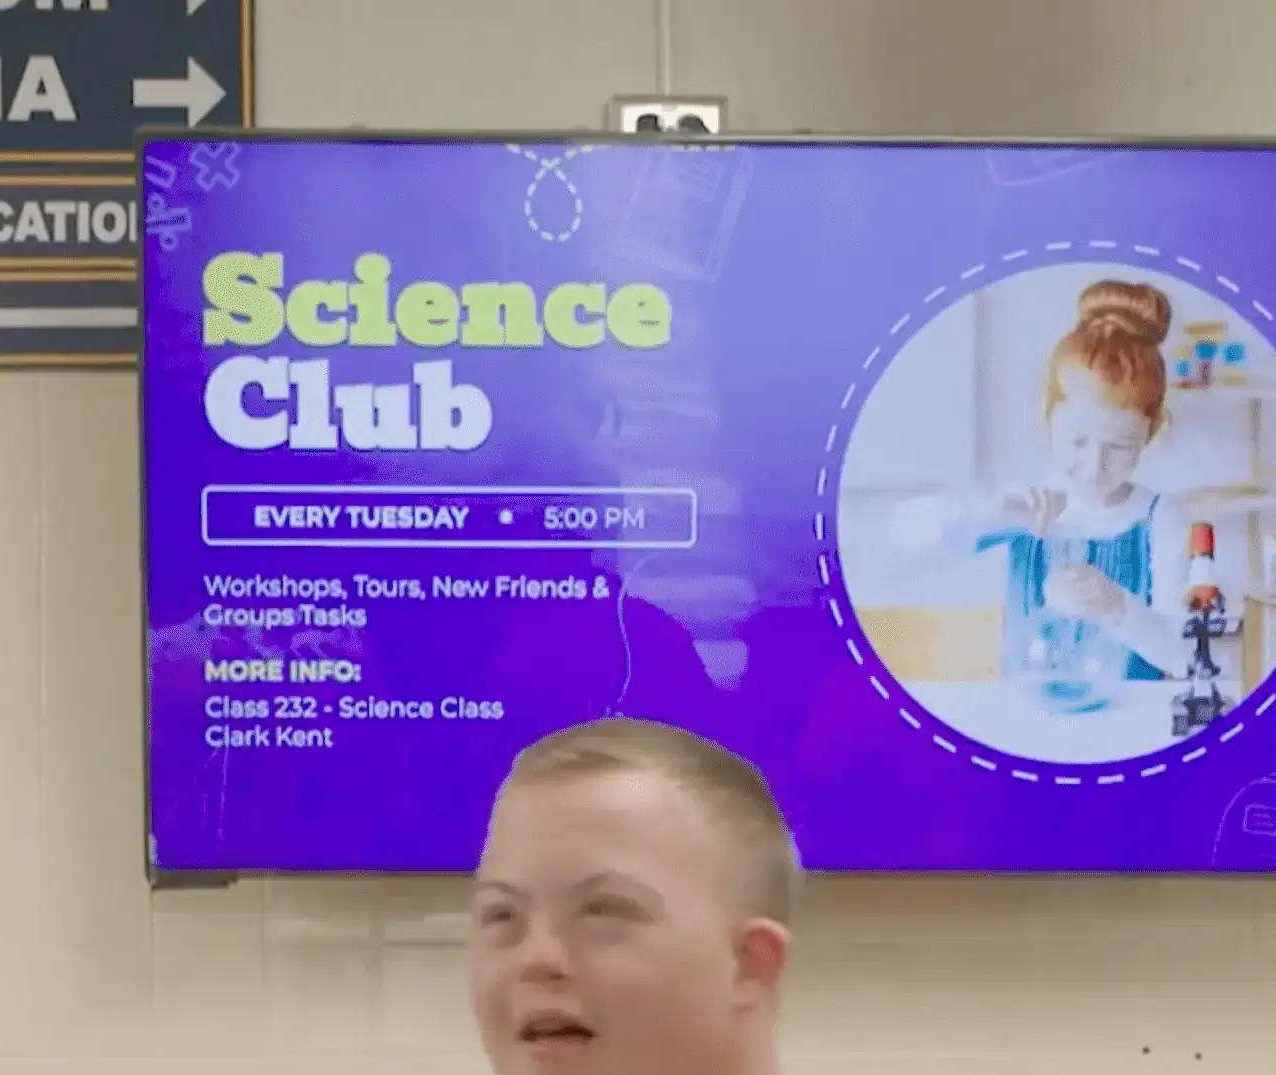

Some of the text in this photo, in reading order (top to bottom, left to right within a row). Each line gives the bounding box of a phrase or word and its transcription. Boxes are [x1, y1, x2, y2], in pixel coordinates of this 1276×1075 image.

[202, 250, 672, 349] Science
[203, 355, 493, 452] Club
[254, 505, 646, 530] EVERY TUESDAY 5:00 PM
[203, 574, 610, 600] Workshops, Tours, New Friends &
[203, 603, 367, 630] Groups Tasks
[204, 659, 361, 683] MORE INFO:
[204, 695, 269, 719] Class
[274, 695, 318, 719] 232
[338, 695, 434, 719] Science
[440, 696, 505, 720] Class
[204, 725, 334, 748] Clark Kent
